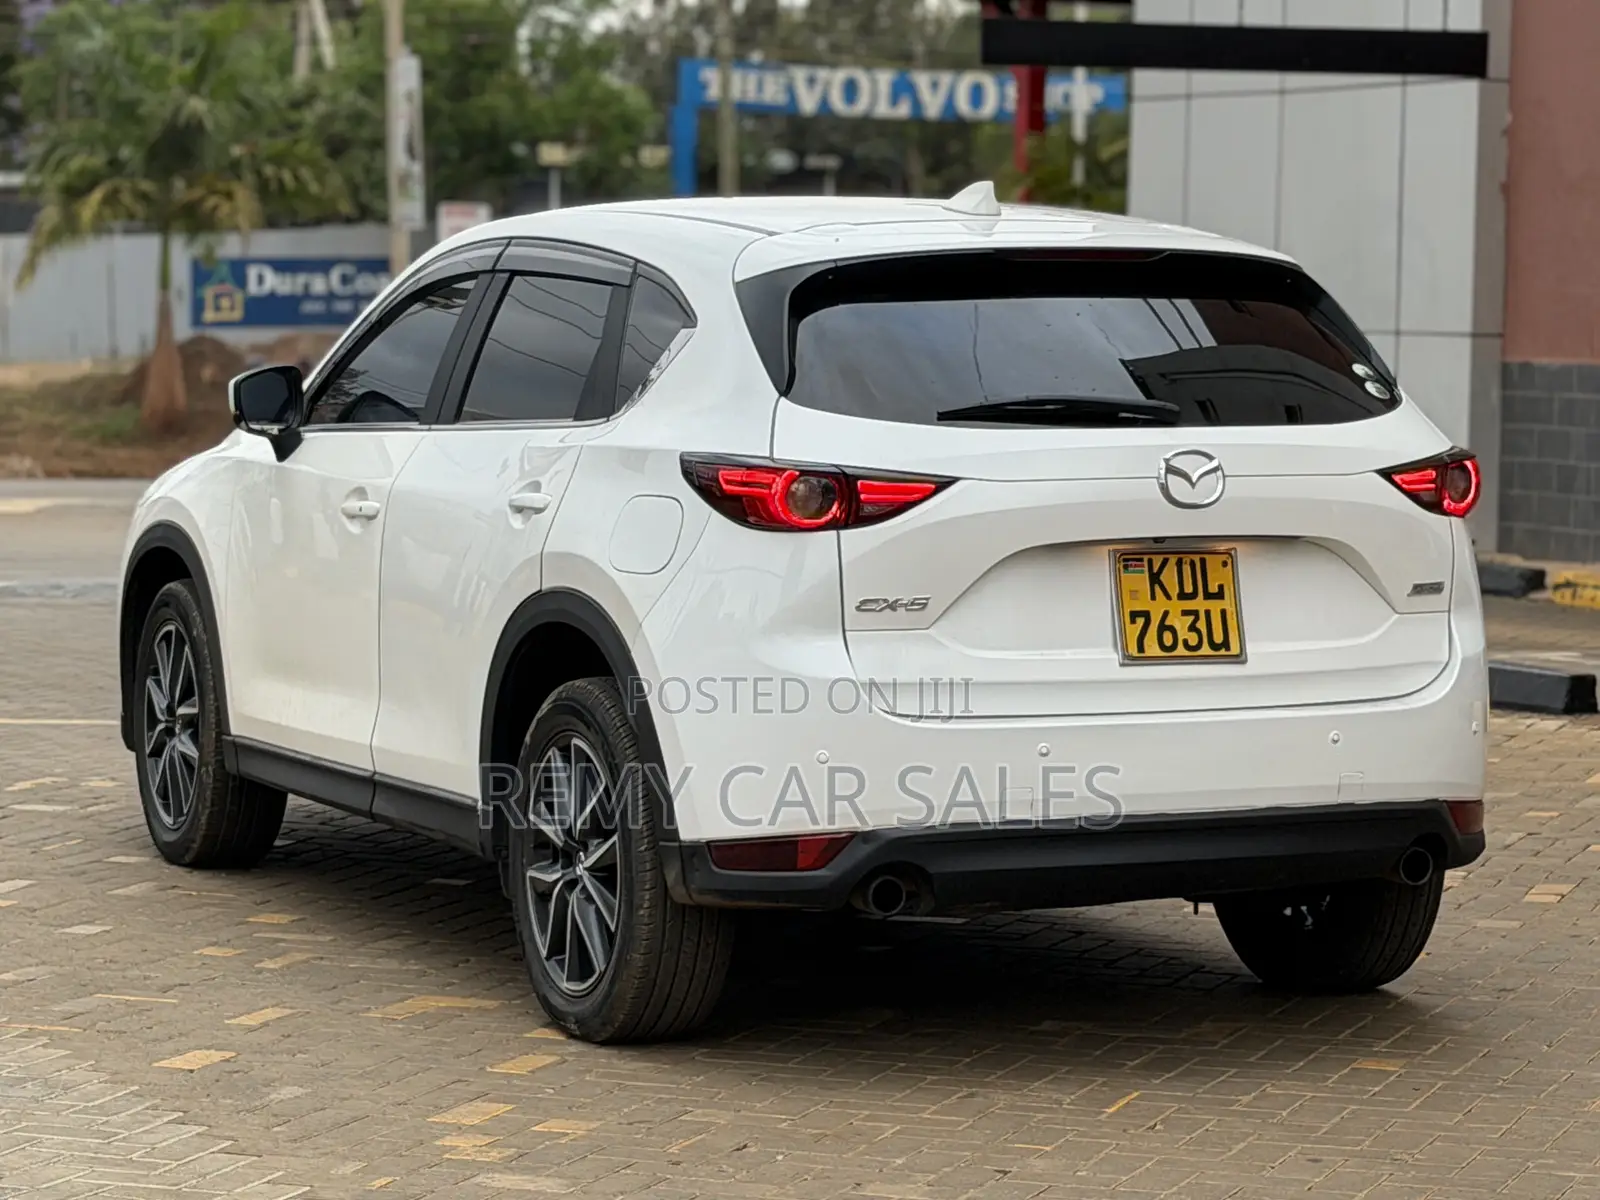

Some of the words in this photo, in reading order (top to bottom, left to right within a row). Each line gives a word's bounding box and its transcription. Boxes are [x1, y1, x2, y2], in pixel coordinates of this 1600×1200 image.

[787, 64, 999, 120] VOLVO
[1147, 556, 1225, 601] KDL
[854, 594, 932, 612] CX-5
[1129, 608, 1231, 654] 763U
